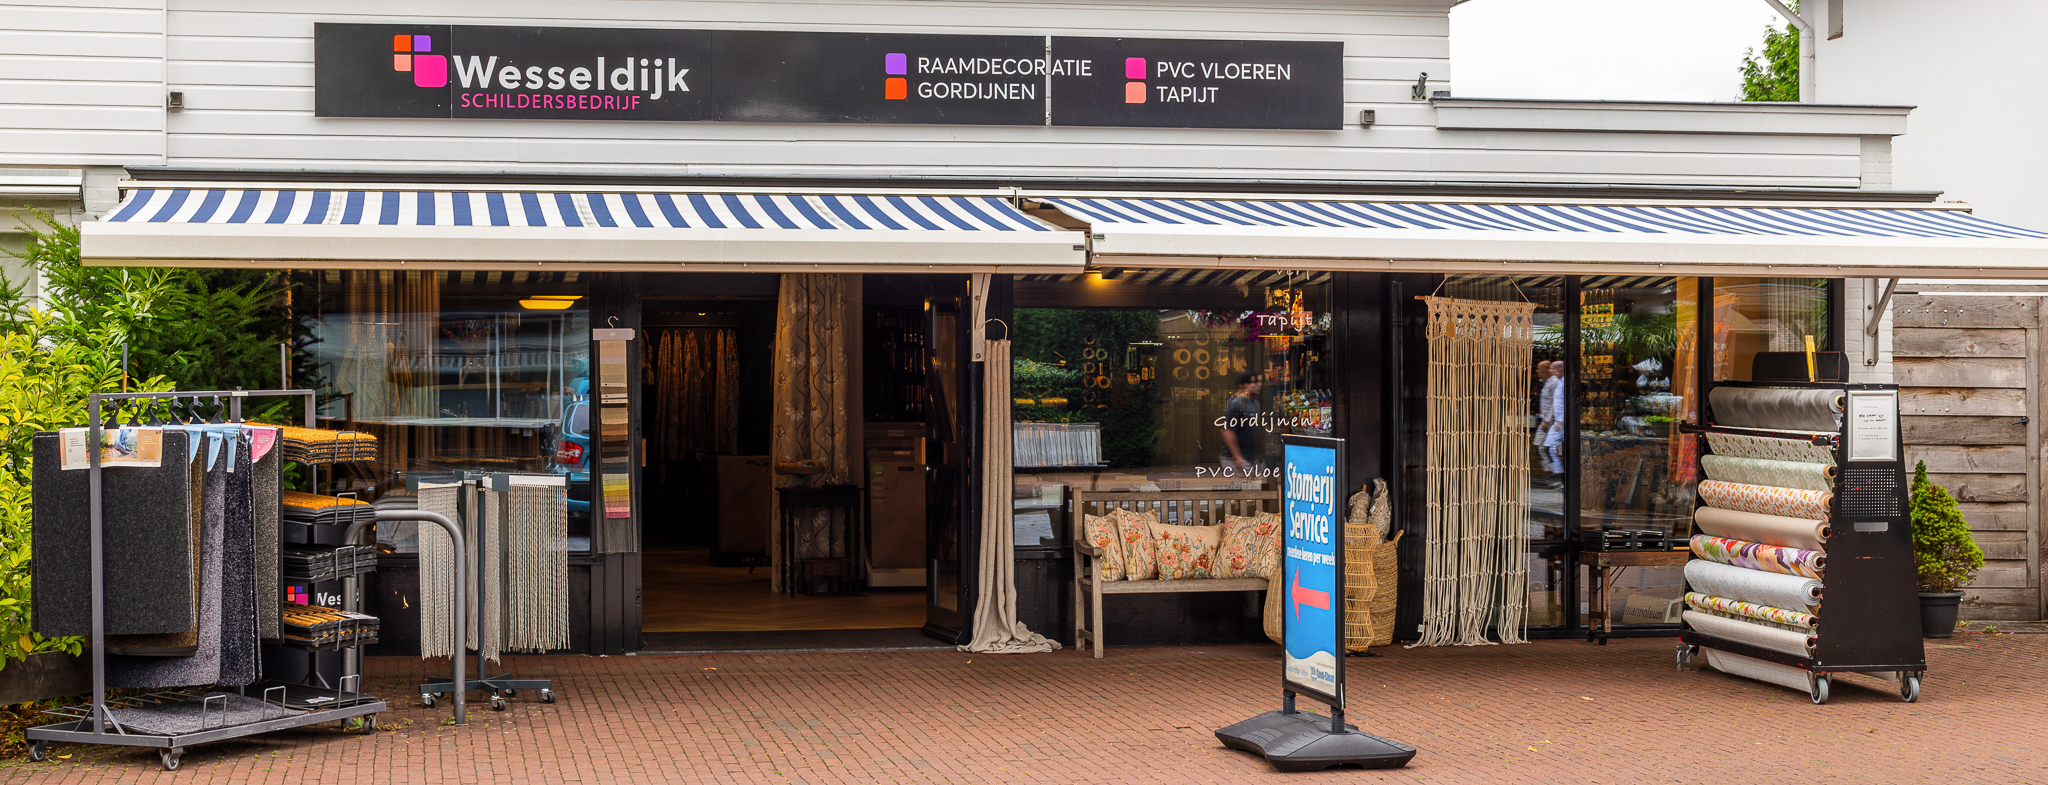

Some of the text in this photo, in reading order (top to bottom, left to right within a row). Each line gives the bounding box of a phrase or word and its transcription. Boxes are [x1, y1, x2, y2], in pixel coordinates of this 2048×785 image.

[918, 56, 1093, 77] RAAMDECORATIE
[1157, 61, 1291, 81] PVC VLOEREN
[453, 55, 690, 100] Wesseldijk
[917, 82, 1036, 100] GORDIJNEN
[1156, 86, 1220, 104] TAPIJT
[460, 92, 641, 111] SCHILDERSBEDRIJF
[1256, 311, 1313, 332] Tapijt
[1213, 411, 1313, 433] Gordijnen
[1194, 464, 1280, 478] PVC vloe
[1287, 461, 1334, 516] Stomerij
[1289, 500, 1329, 544] Service
[1313, 552, 1321, 566] per
[1624, 606, 1664, 621] marmoleum
